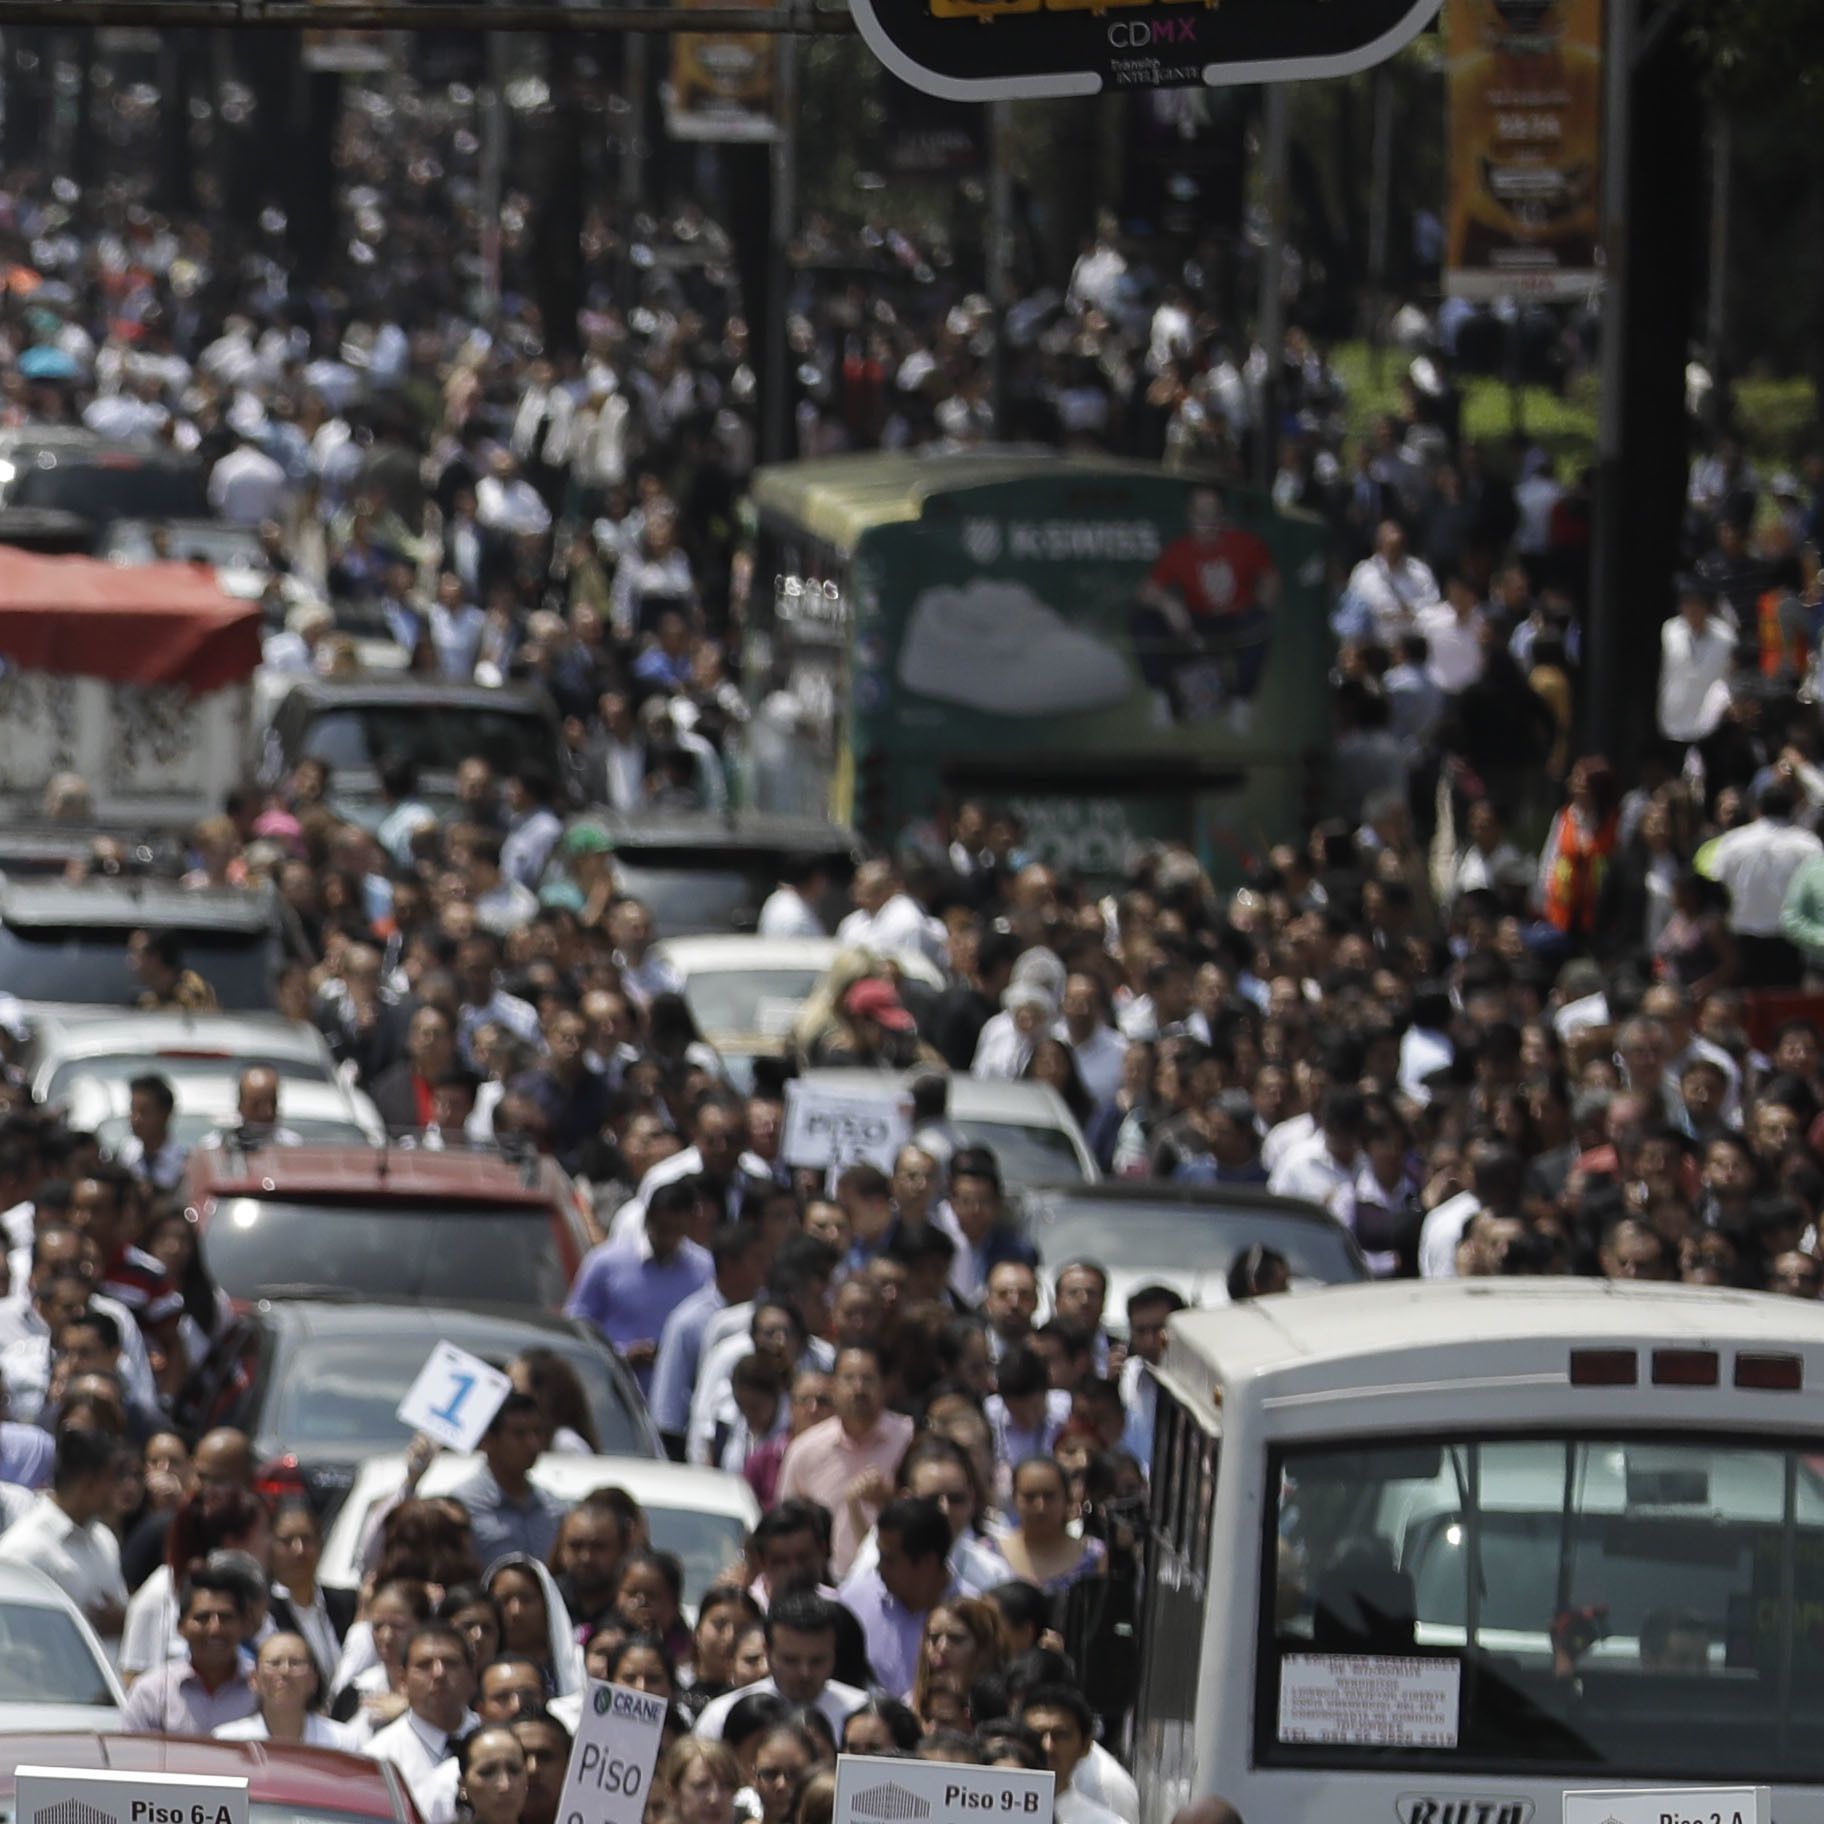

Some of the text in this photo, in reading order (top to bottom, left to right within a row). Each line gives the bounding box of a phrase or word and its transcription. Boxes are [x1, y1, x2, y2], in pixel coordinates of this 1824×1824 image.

[1107, 16, 1197, 48] CDMX
[429, 1372, 478, 1428] 1
[613, 1692, 663, 1722] CRANE
[131, 1801, 184, 1824] Piso
[945, 1785, 1040, 1813] Piso 9-B
